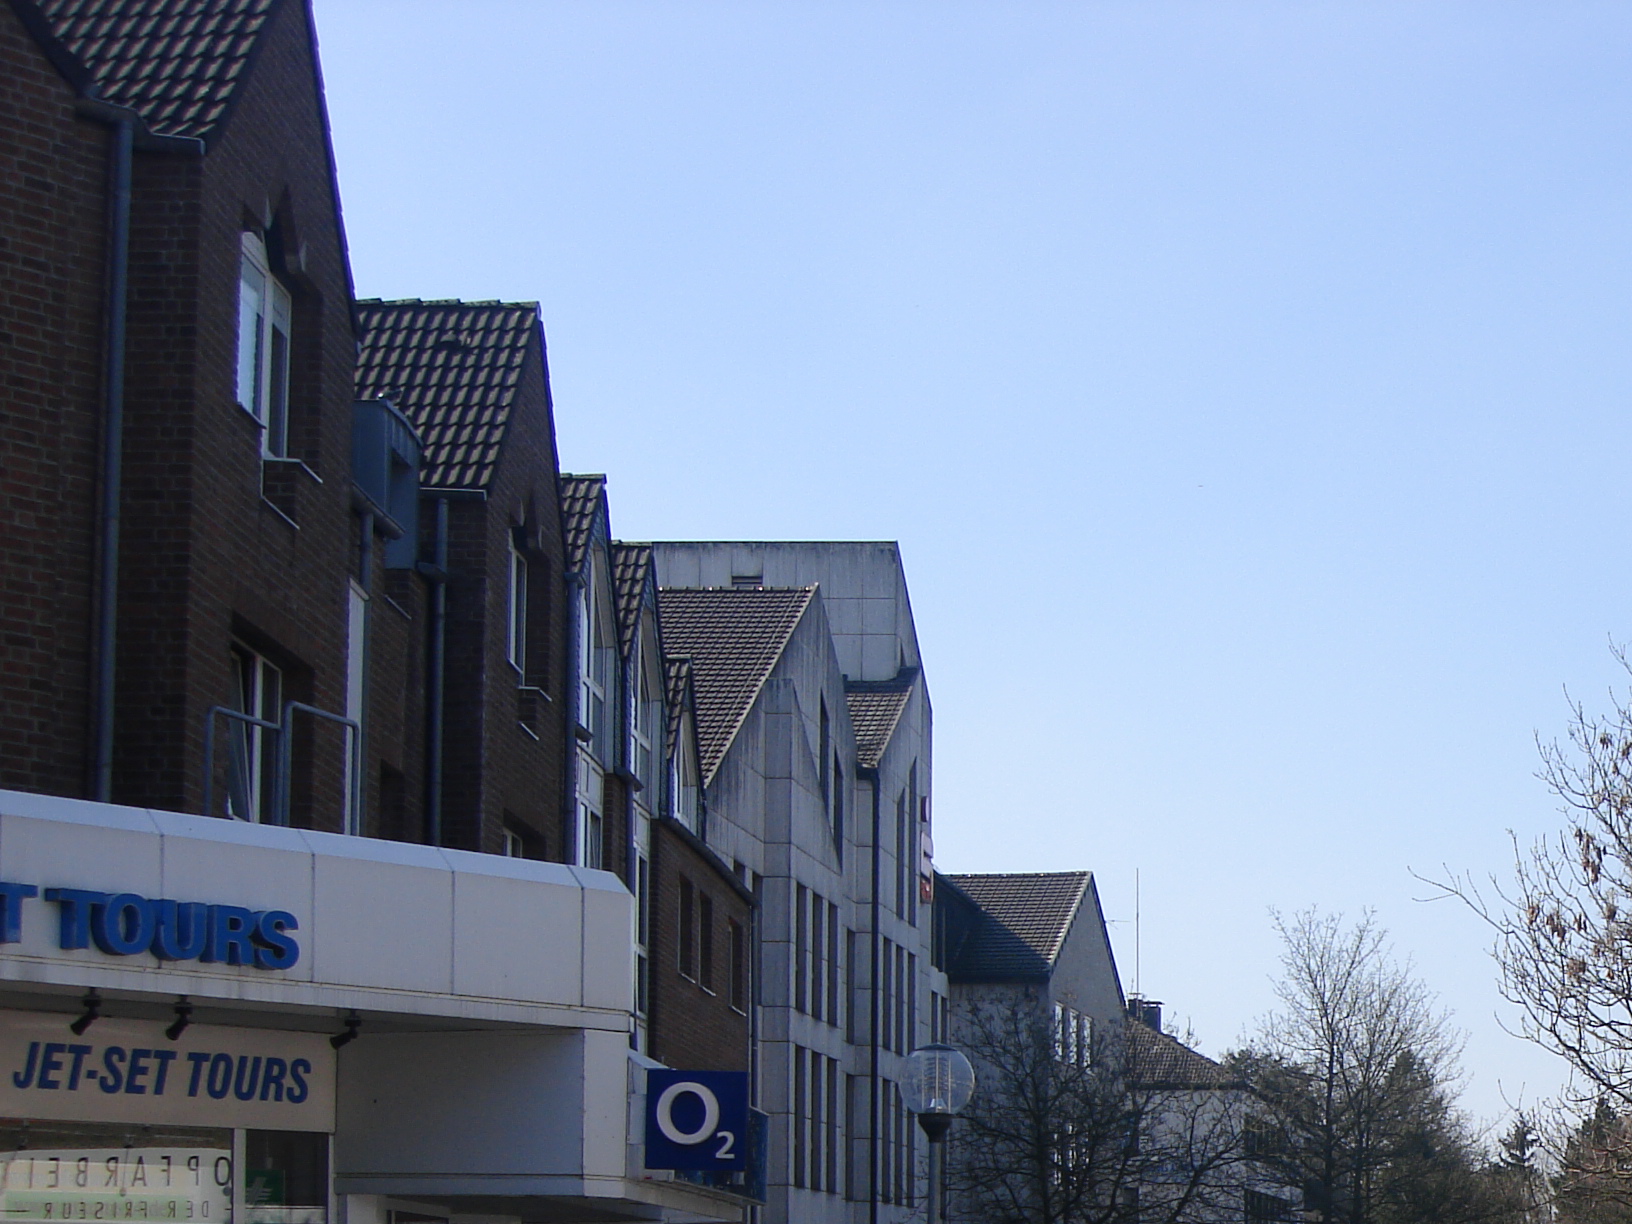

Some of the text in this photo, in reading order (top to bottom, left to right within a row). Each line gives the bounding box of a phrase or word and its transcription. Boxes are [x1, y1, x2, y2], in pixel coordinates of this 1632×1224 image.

[45, 887, 299, 970] TOURS
[13, 1041, 311, 1103] JET-SET TOURS
[656, 1081, 736, 1159] O2
